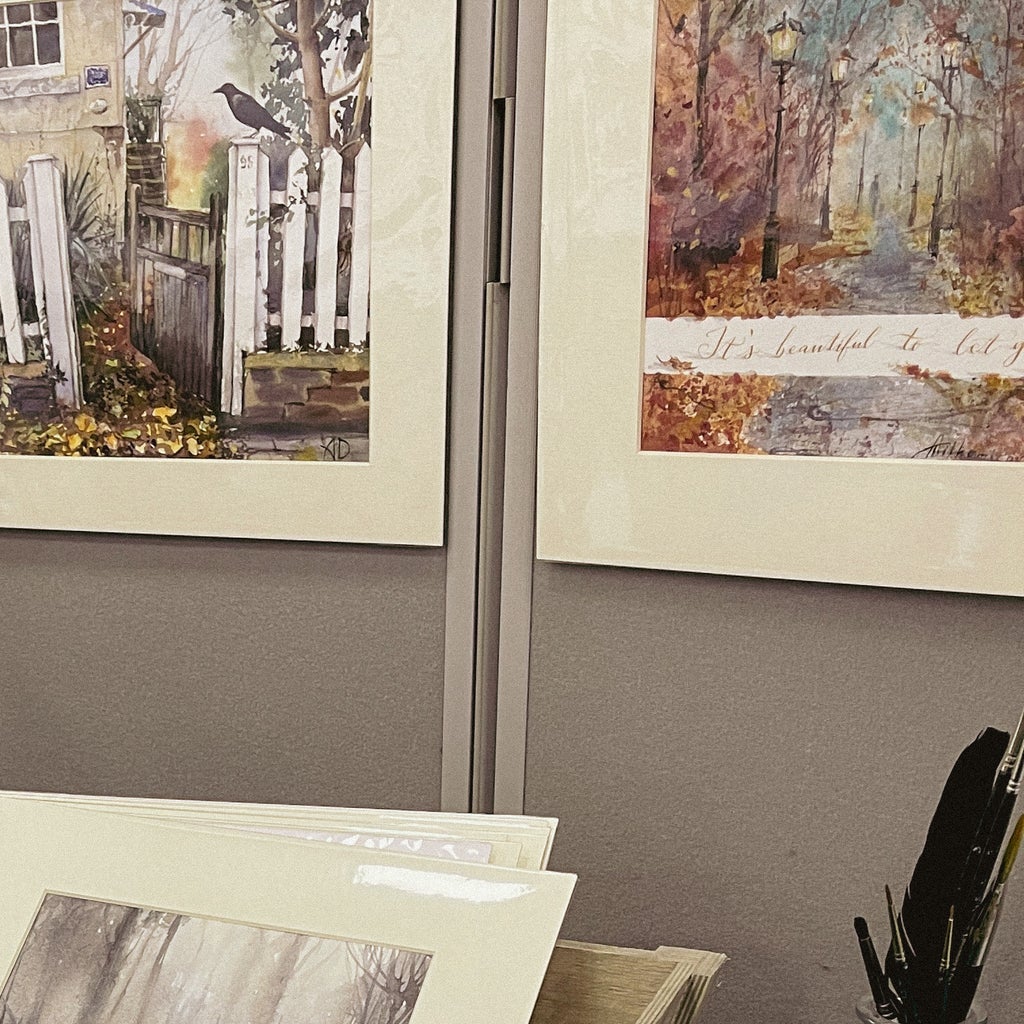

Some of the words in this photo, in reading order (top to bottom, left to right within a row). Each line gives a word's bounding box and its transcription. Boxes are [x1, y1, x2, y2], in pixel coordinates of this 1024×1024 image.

[697, 325, 755, 360] It's
[774, 325, 880, 362] beautiful
[896, 327, 921, 351] to
[952, 327, 1000, 356] let
